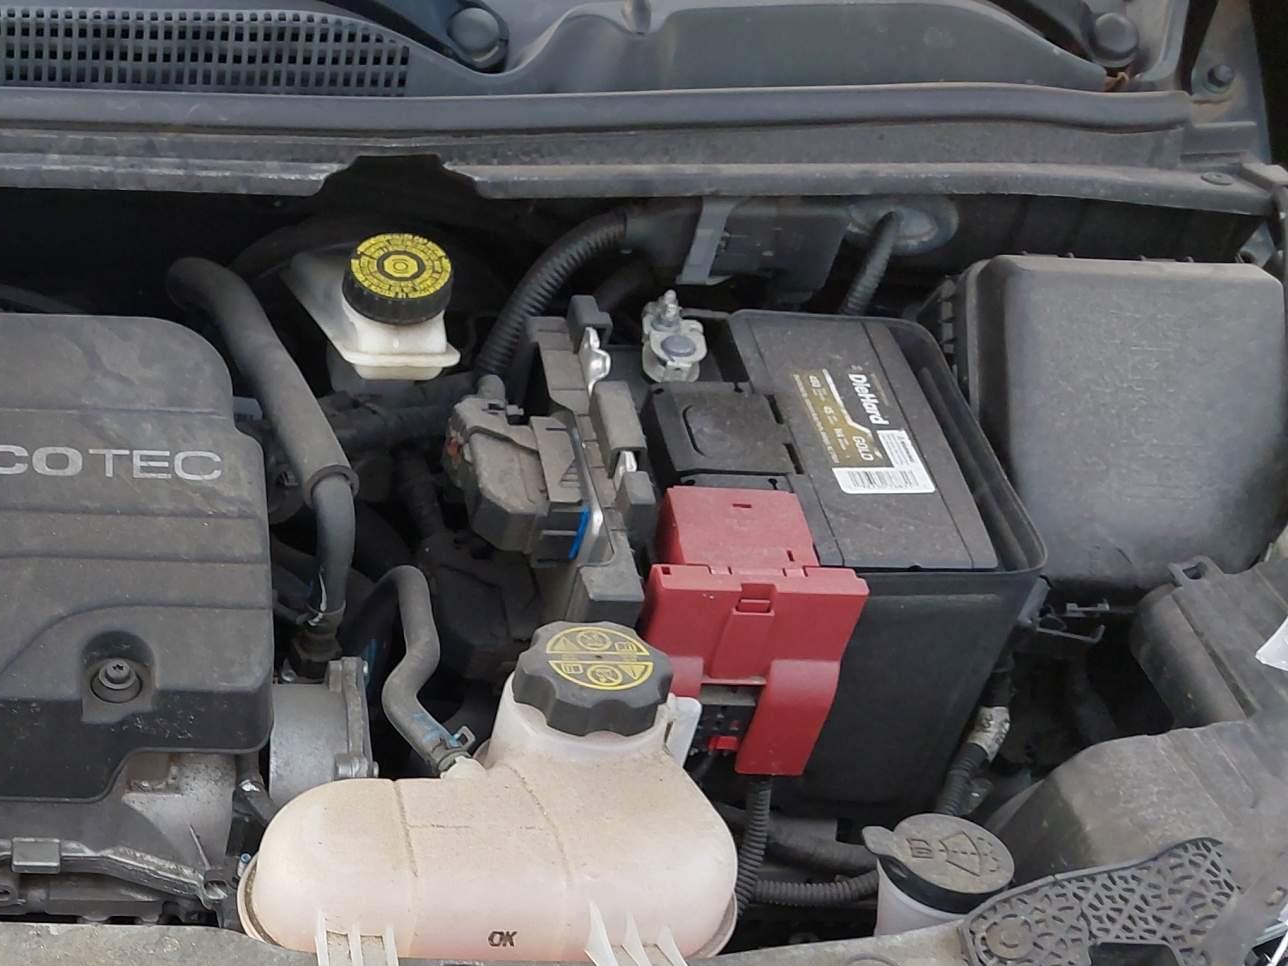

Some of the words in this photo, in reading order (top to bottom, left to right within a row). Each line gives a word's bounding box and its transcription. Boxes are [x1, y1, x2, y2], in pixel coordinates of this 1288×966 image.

[848, 373, 890, 425] DieHard
[852, 435, 874, 461] GOLD
[488, 931, 518, 947] OK
